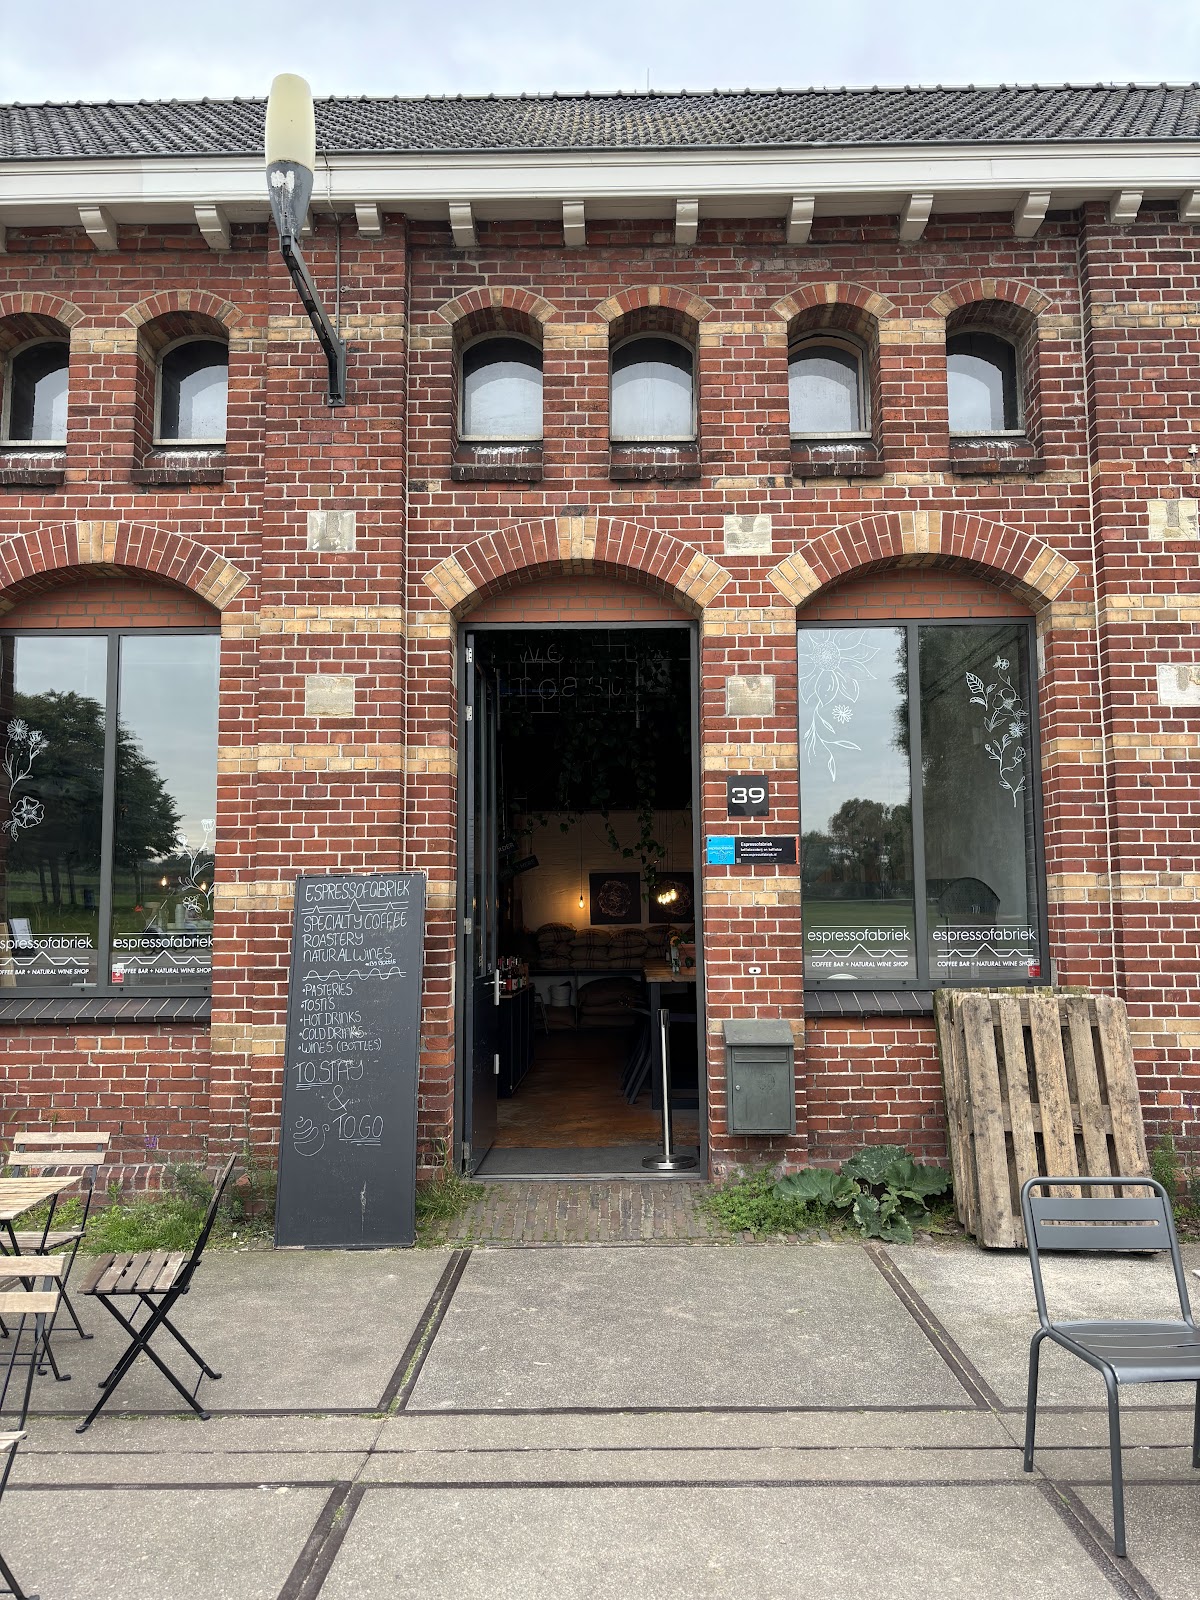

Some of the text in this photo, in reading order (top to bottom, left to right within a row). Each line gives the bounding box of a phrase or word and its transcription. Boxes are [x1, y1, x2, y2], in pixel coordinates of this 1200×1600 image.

[731, 787, 765, 804] 39
[303, 911, 408, 932] SPECIALTY COFFEE
[113, 935, 213, 951] espressofabriek
[302, 931, 364, 948] ROASTERY
[807, 928, 911, 944] espressofabriek
[932, 927, 1037, 944] espressofabriek
[0, 936, 94, 952] spressofabriek
[303, 947, 352, 962] NATURAL
[304, 982, 353, 997] PASTERIES
[303, 1012, 323, 1026] HOT
[301, 1027, 326, 1040] COLD
[293, 1058, 365, 1083] TO STAY
[327, 1084, 351, 1112] &
[332, 1112, 384, 1139] TO GO
